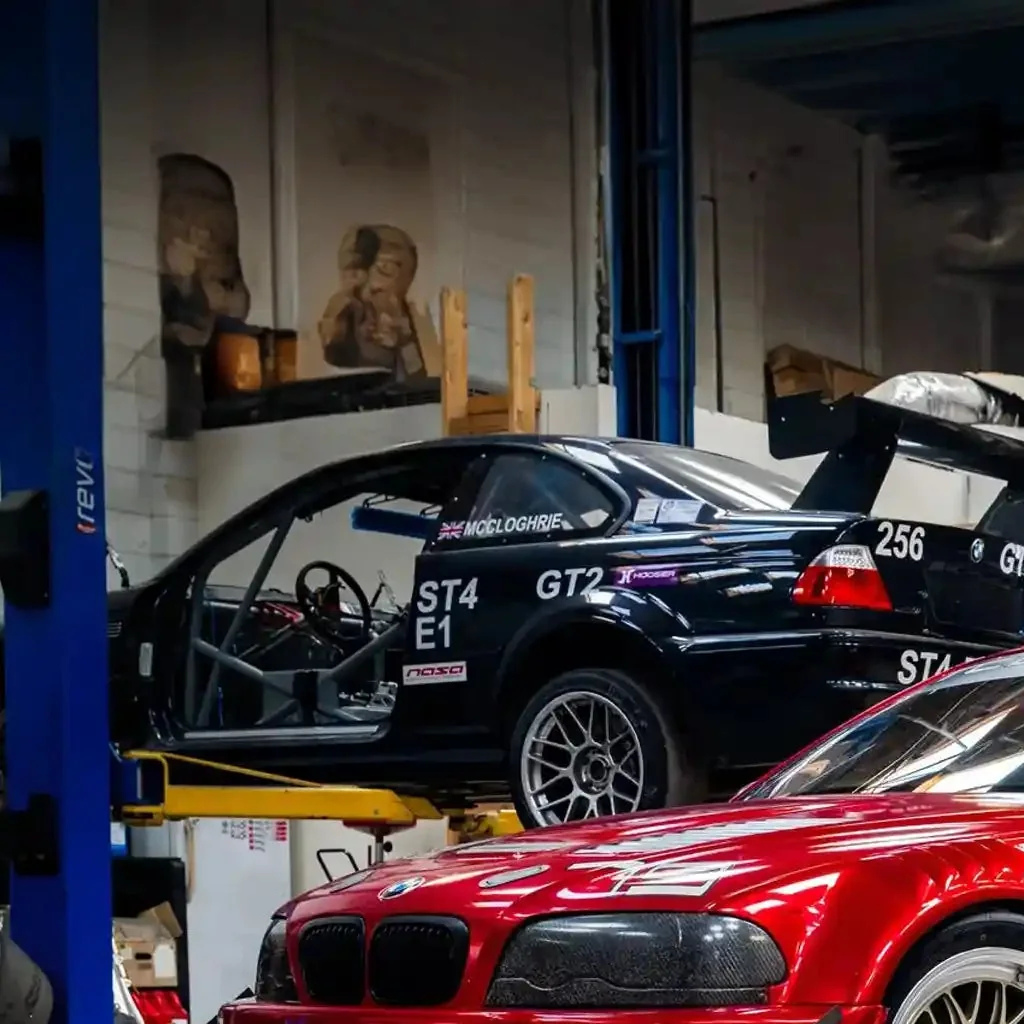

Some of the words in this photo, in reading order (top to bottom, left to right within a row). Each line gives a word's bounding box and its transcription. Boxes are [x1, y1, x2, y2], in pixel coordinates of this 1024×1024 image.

[463, 513, 563, 537] MCCLOGHRIE
[875, 521, 926, 562] 256
[416, 577, 479, 614] ST4
[536, 567, 605, 600] GT2
[416, 615, 451, 650] E1
